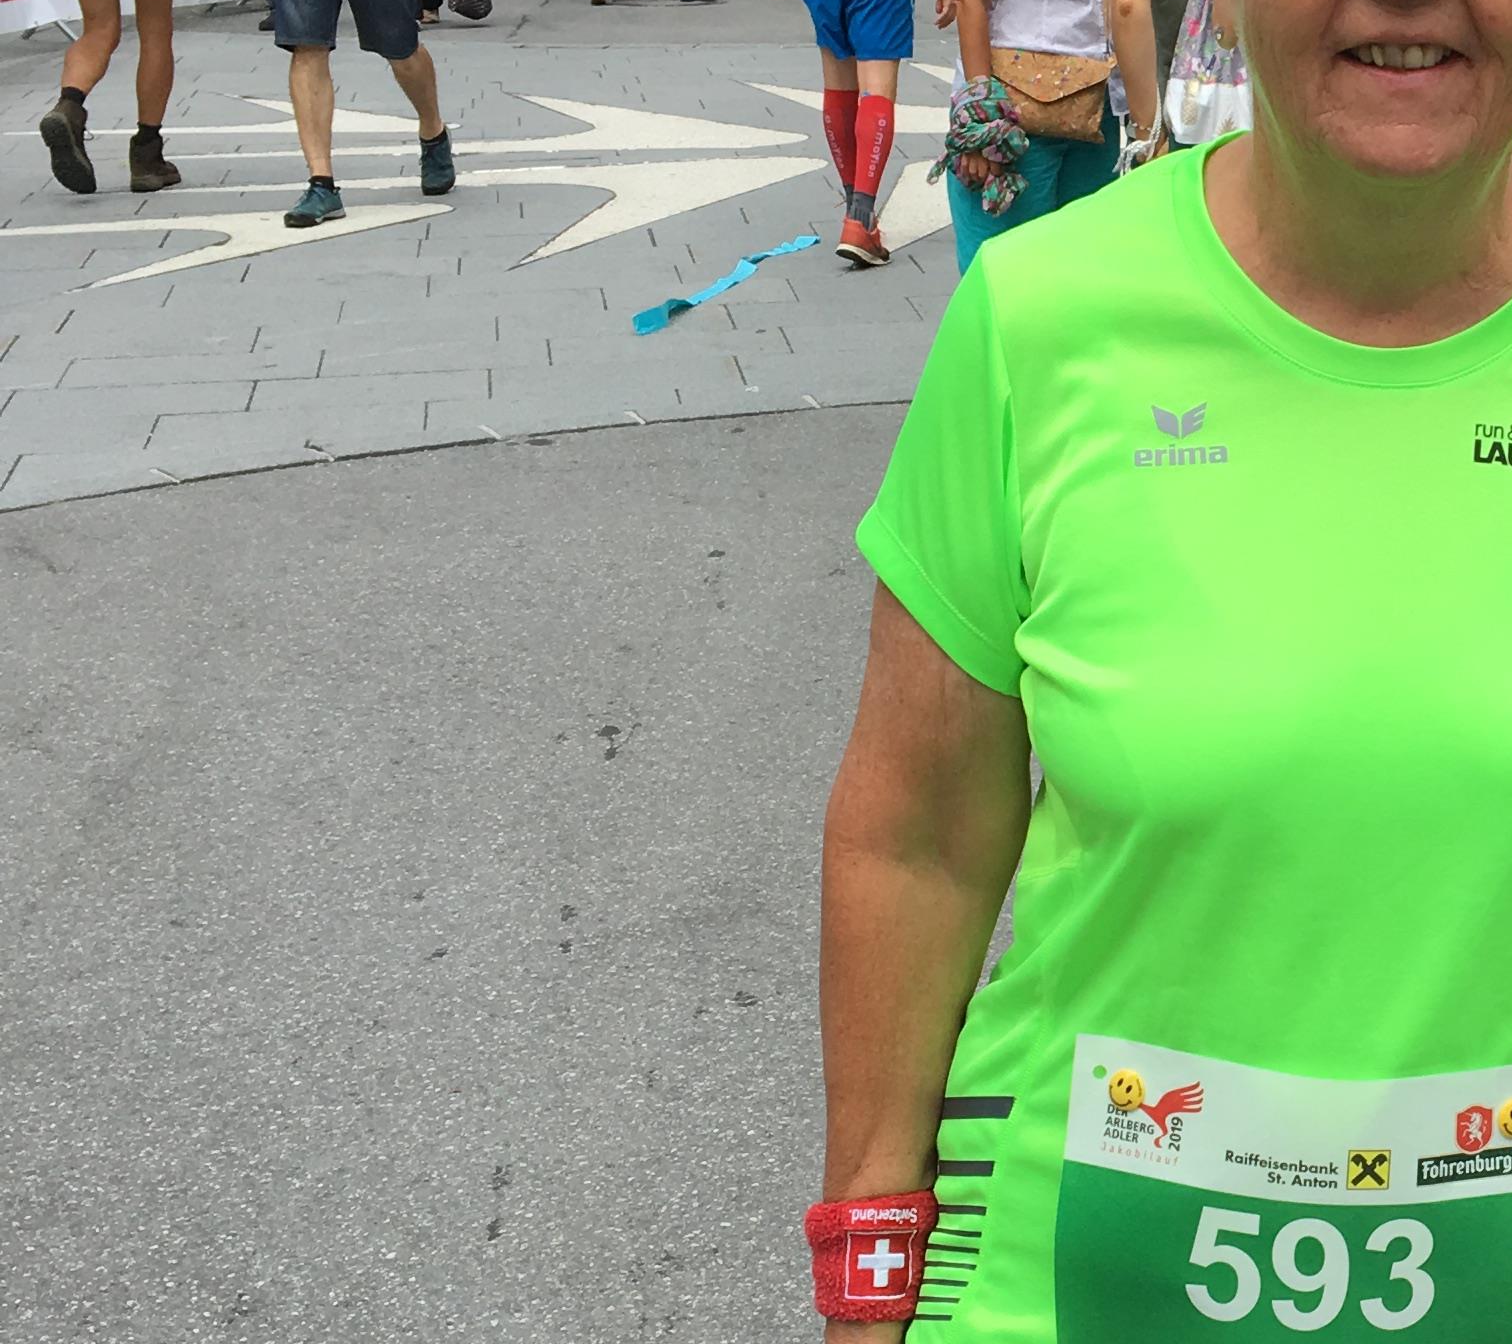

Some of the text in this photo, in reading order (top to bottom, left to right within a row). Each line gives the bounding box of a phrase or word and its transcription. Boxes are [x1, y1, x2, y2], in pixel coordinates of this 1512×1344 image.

[1474, 424, 1505, 440] run
[1134, 443, 1228, 467] erima
[1103, 1127, 1140, 1144] ADLER
[1104, 1115, 1155, 1136] ARLBERG
[1168, 1116, 1184, 1152] 2019
[1101, 1141, 1179, 1166] Jakobilauf
[1224, 1149, 1339, 1176] Raiffeisenbank
[1267, 1171, 1338, 1189] St. Anton
[1183, 1204, 1436, 1332] 593
